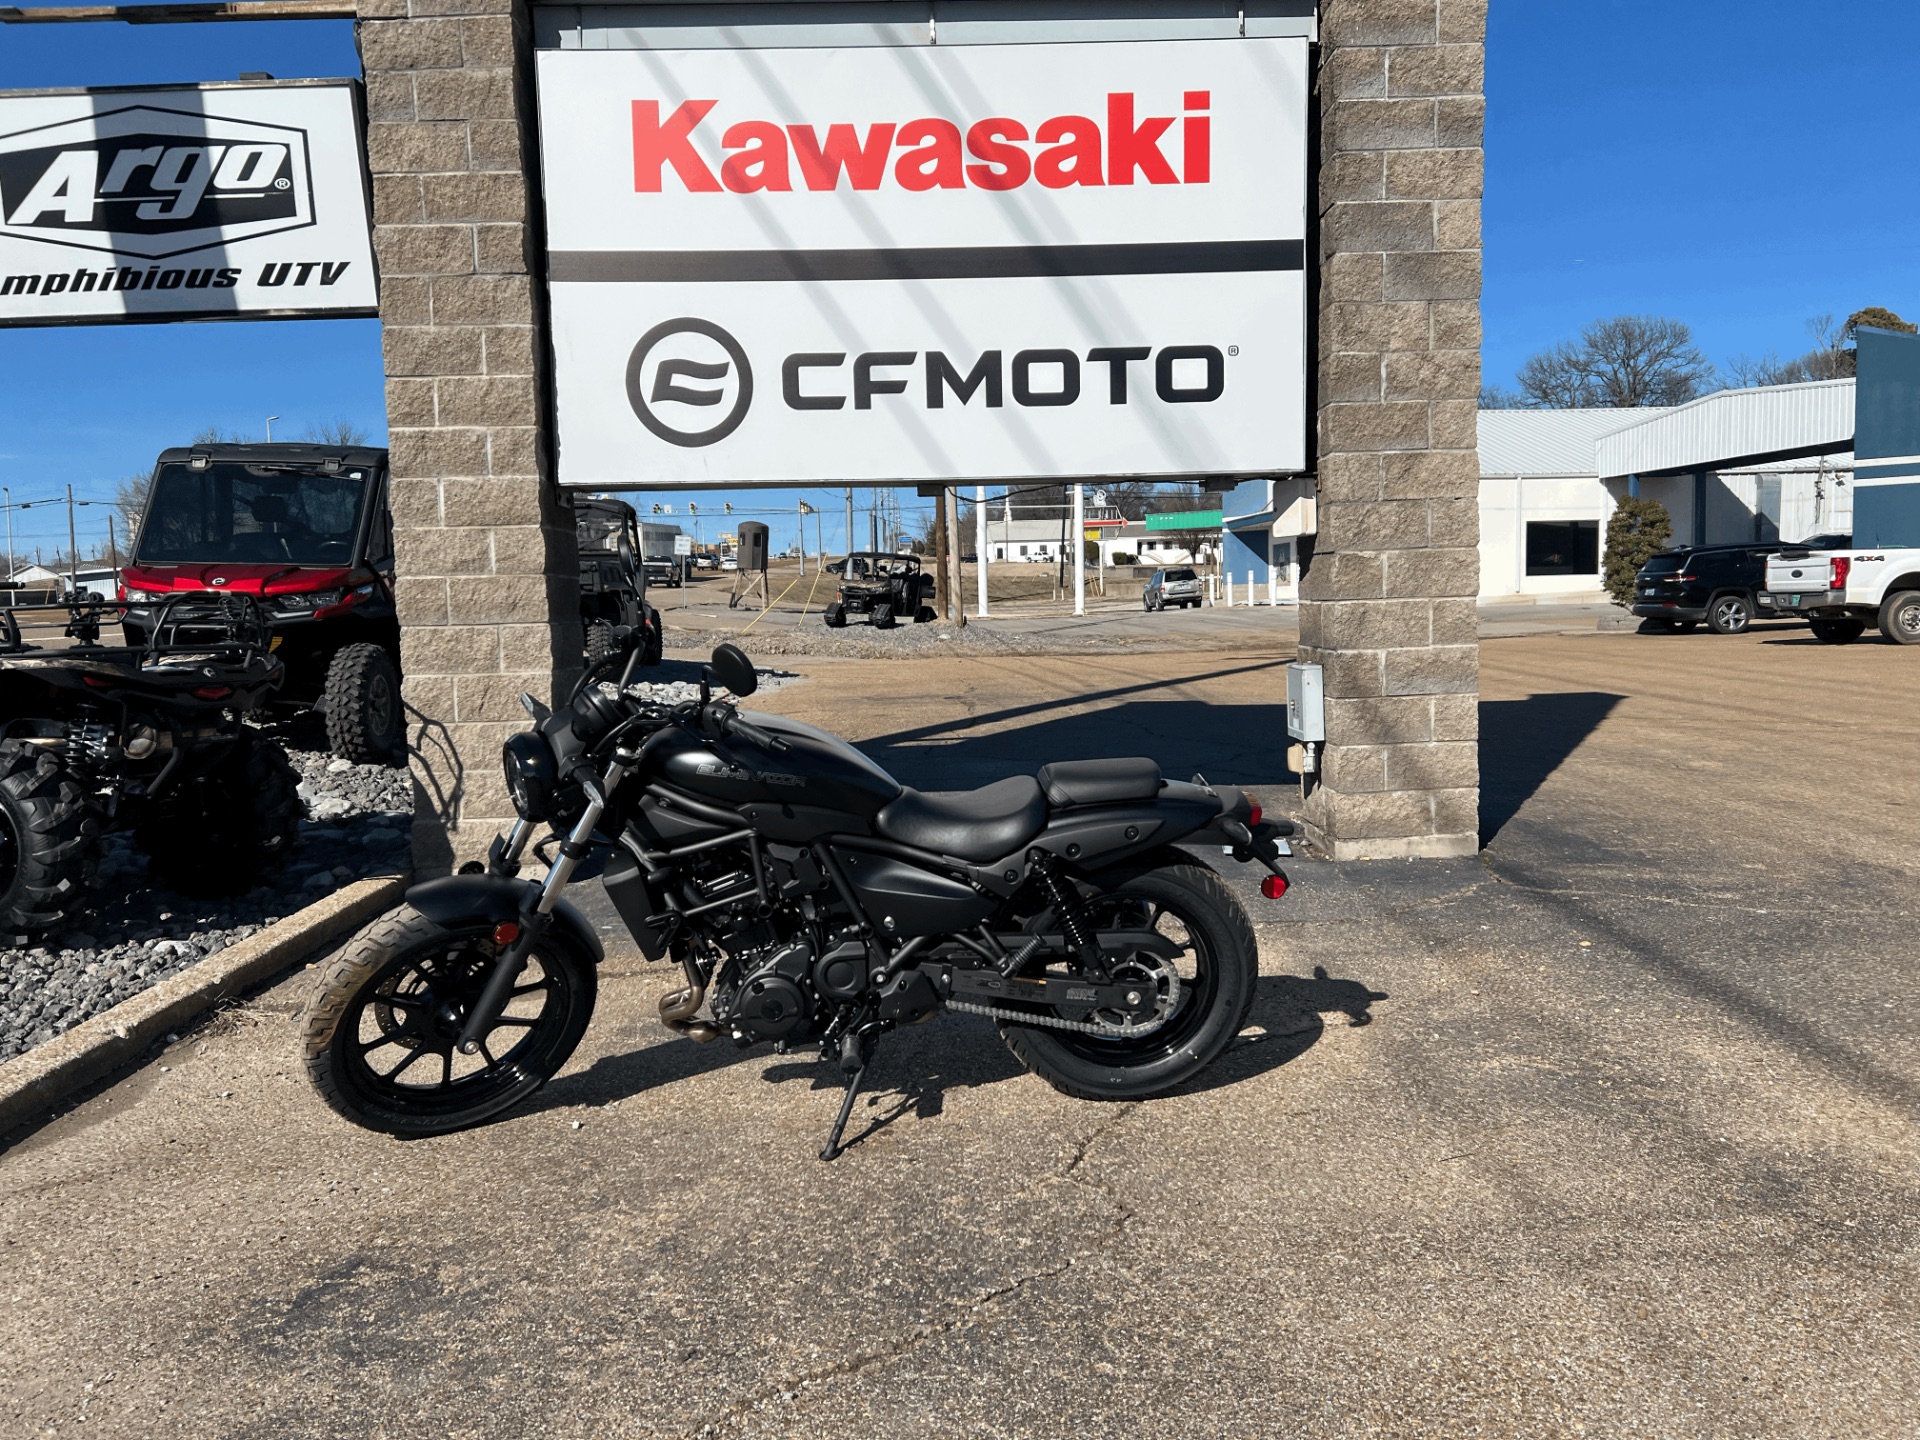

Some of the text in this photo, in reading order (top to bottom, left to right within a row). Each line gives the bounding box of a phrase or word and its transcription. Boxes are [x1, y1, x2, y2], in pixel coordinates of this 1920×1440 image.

[631, 90, 1210, 193] Kawasaki
[6, 144, 287, 224] Argo
[0, 261, 350, 296] mphibious UTV
[781, 345, 1225, 410] CFMOTO
